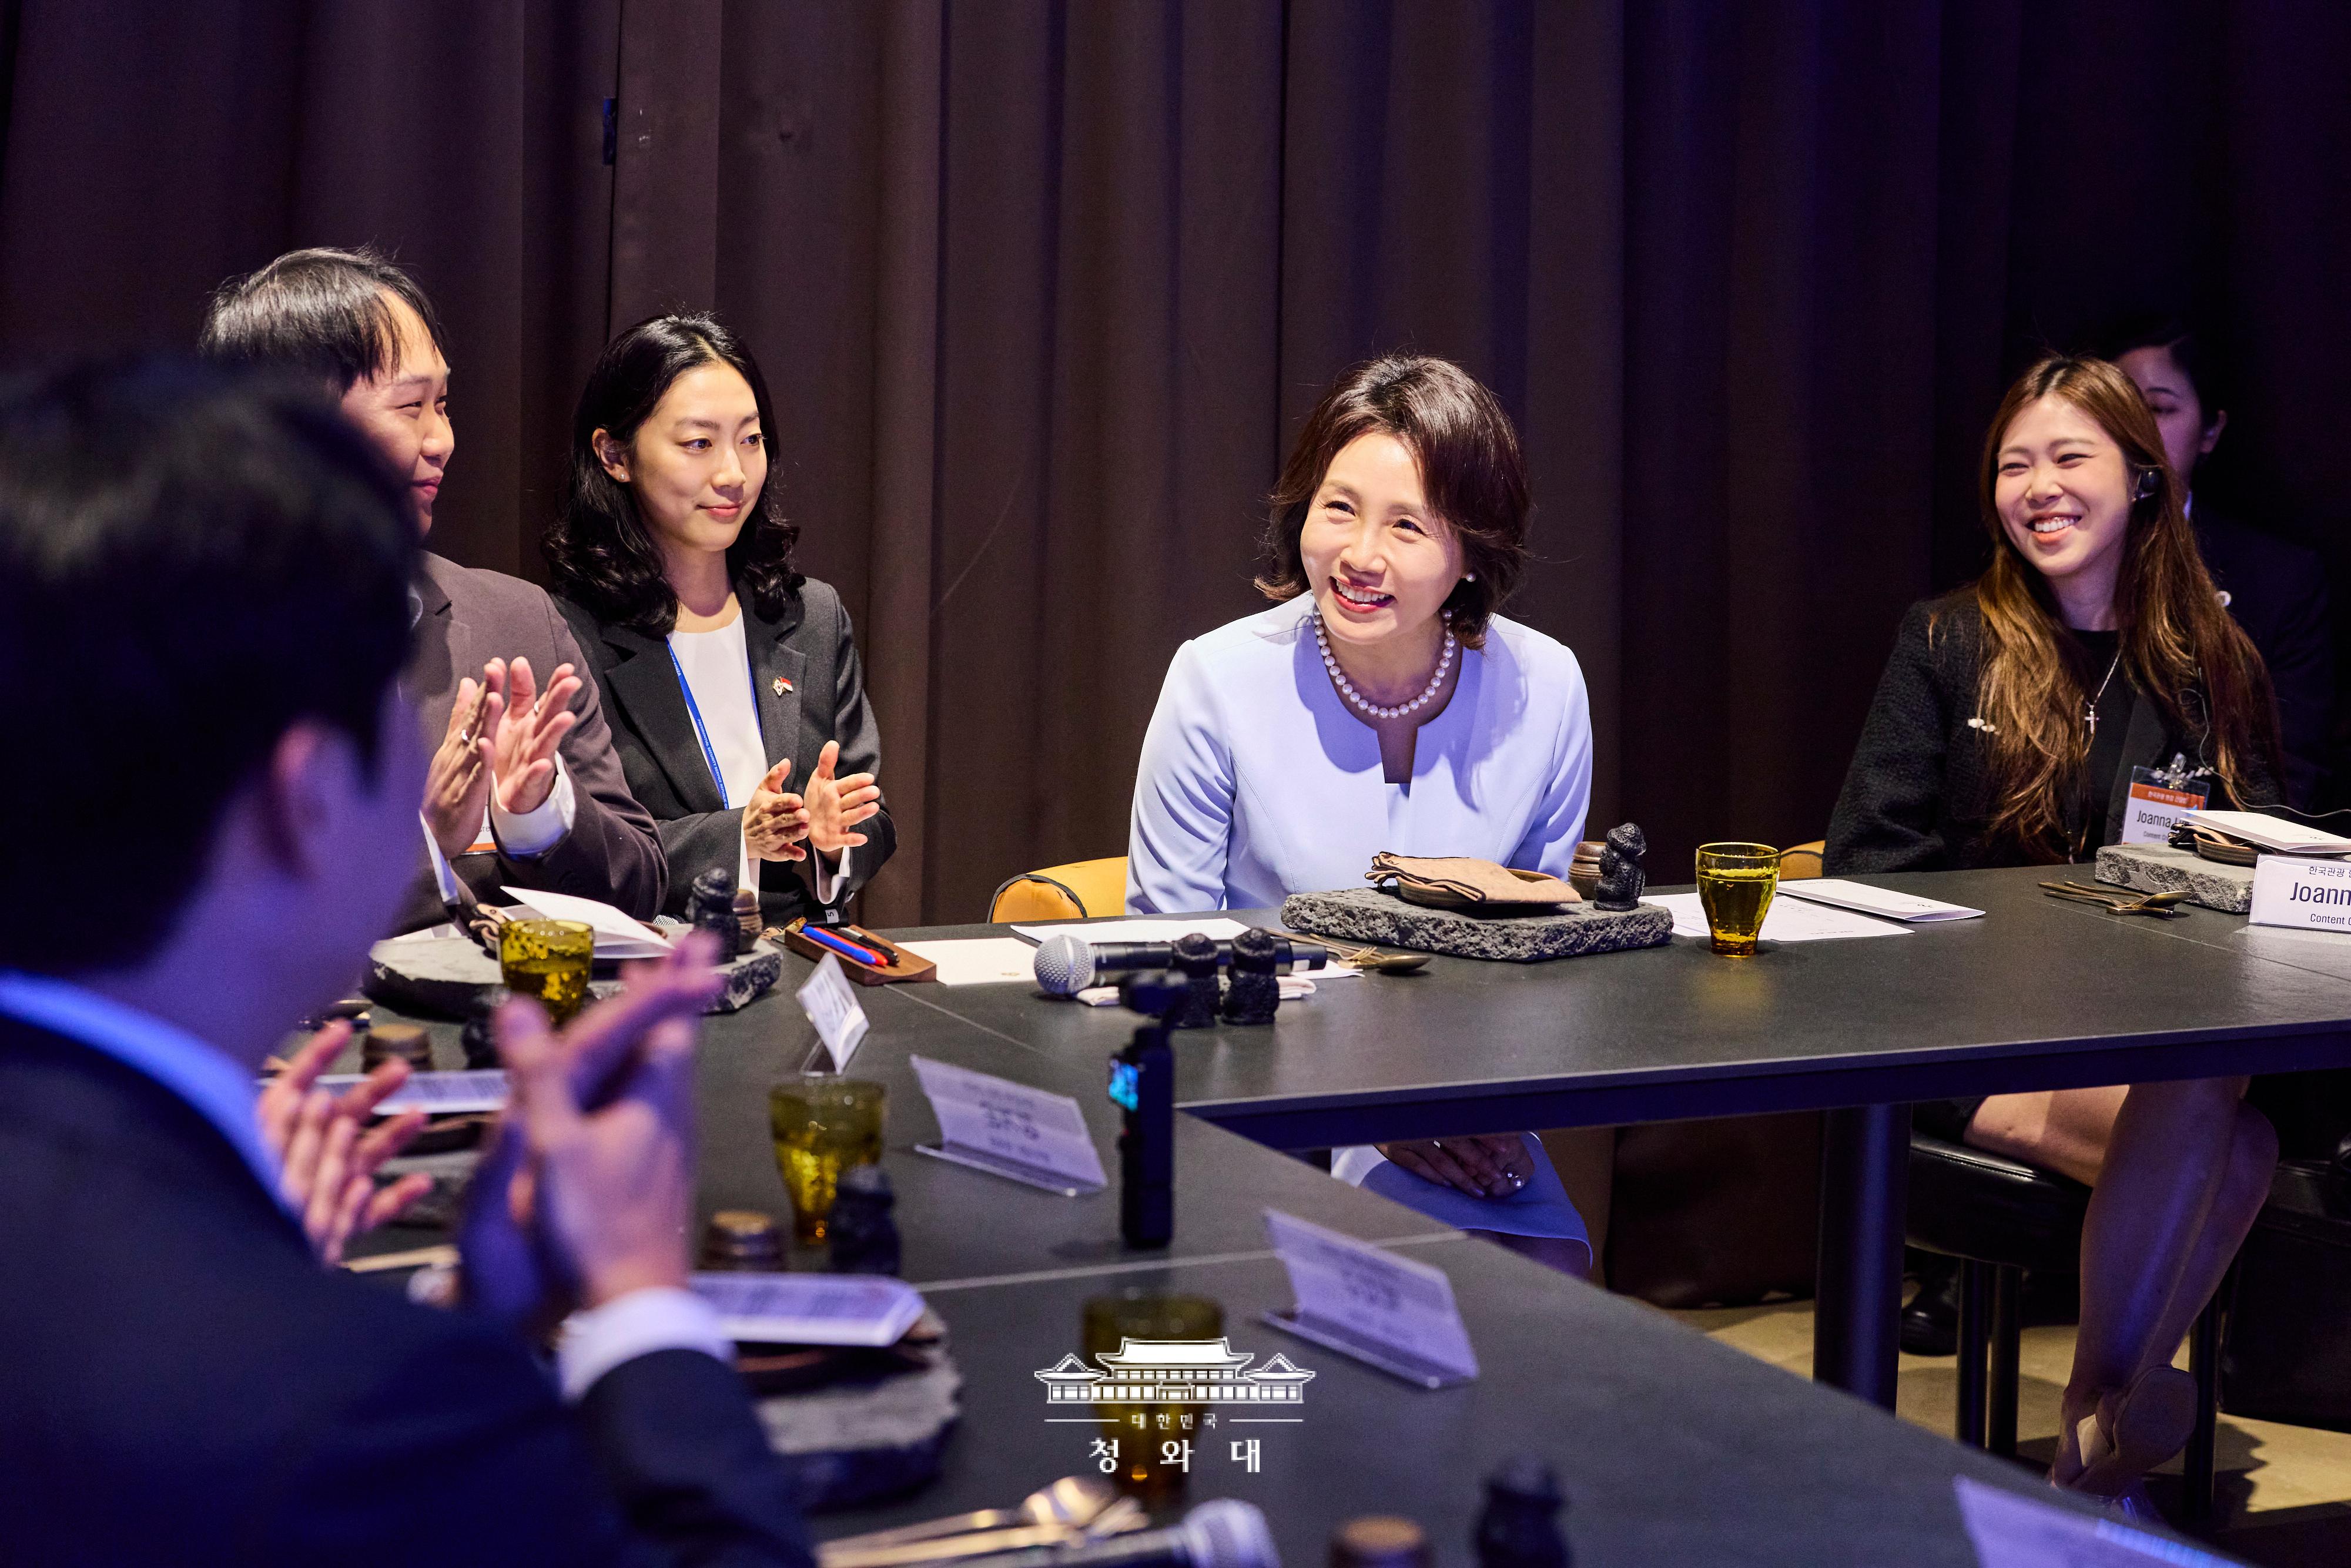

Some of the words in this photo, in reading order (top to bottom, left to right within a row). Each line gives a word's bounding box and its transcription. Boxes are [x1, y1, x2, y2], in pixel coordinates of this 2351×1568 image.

[697, 719, 709, 747] PRESIDENTIAL
[707, 746, 717, 766] SECURITY
[714, 766, 722, 783] SERVICE
[2137, 810, 2171, 828] Joanna
[2309, 866, 2345, 877] 한국관광
[2310, 913, 2345, 925] Content
